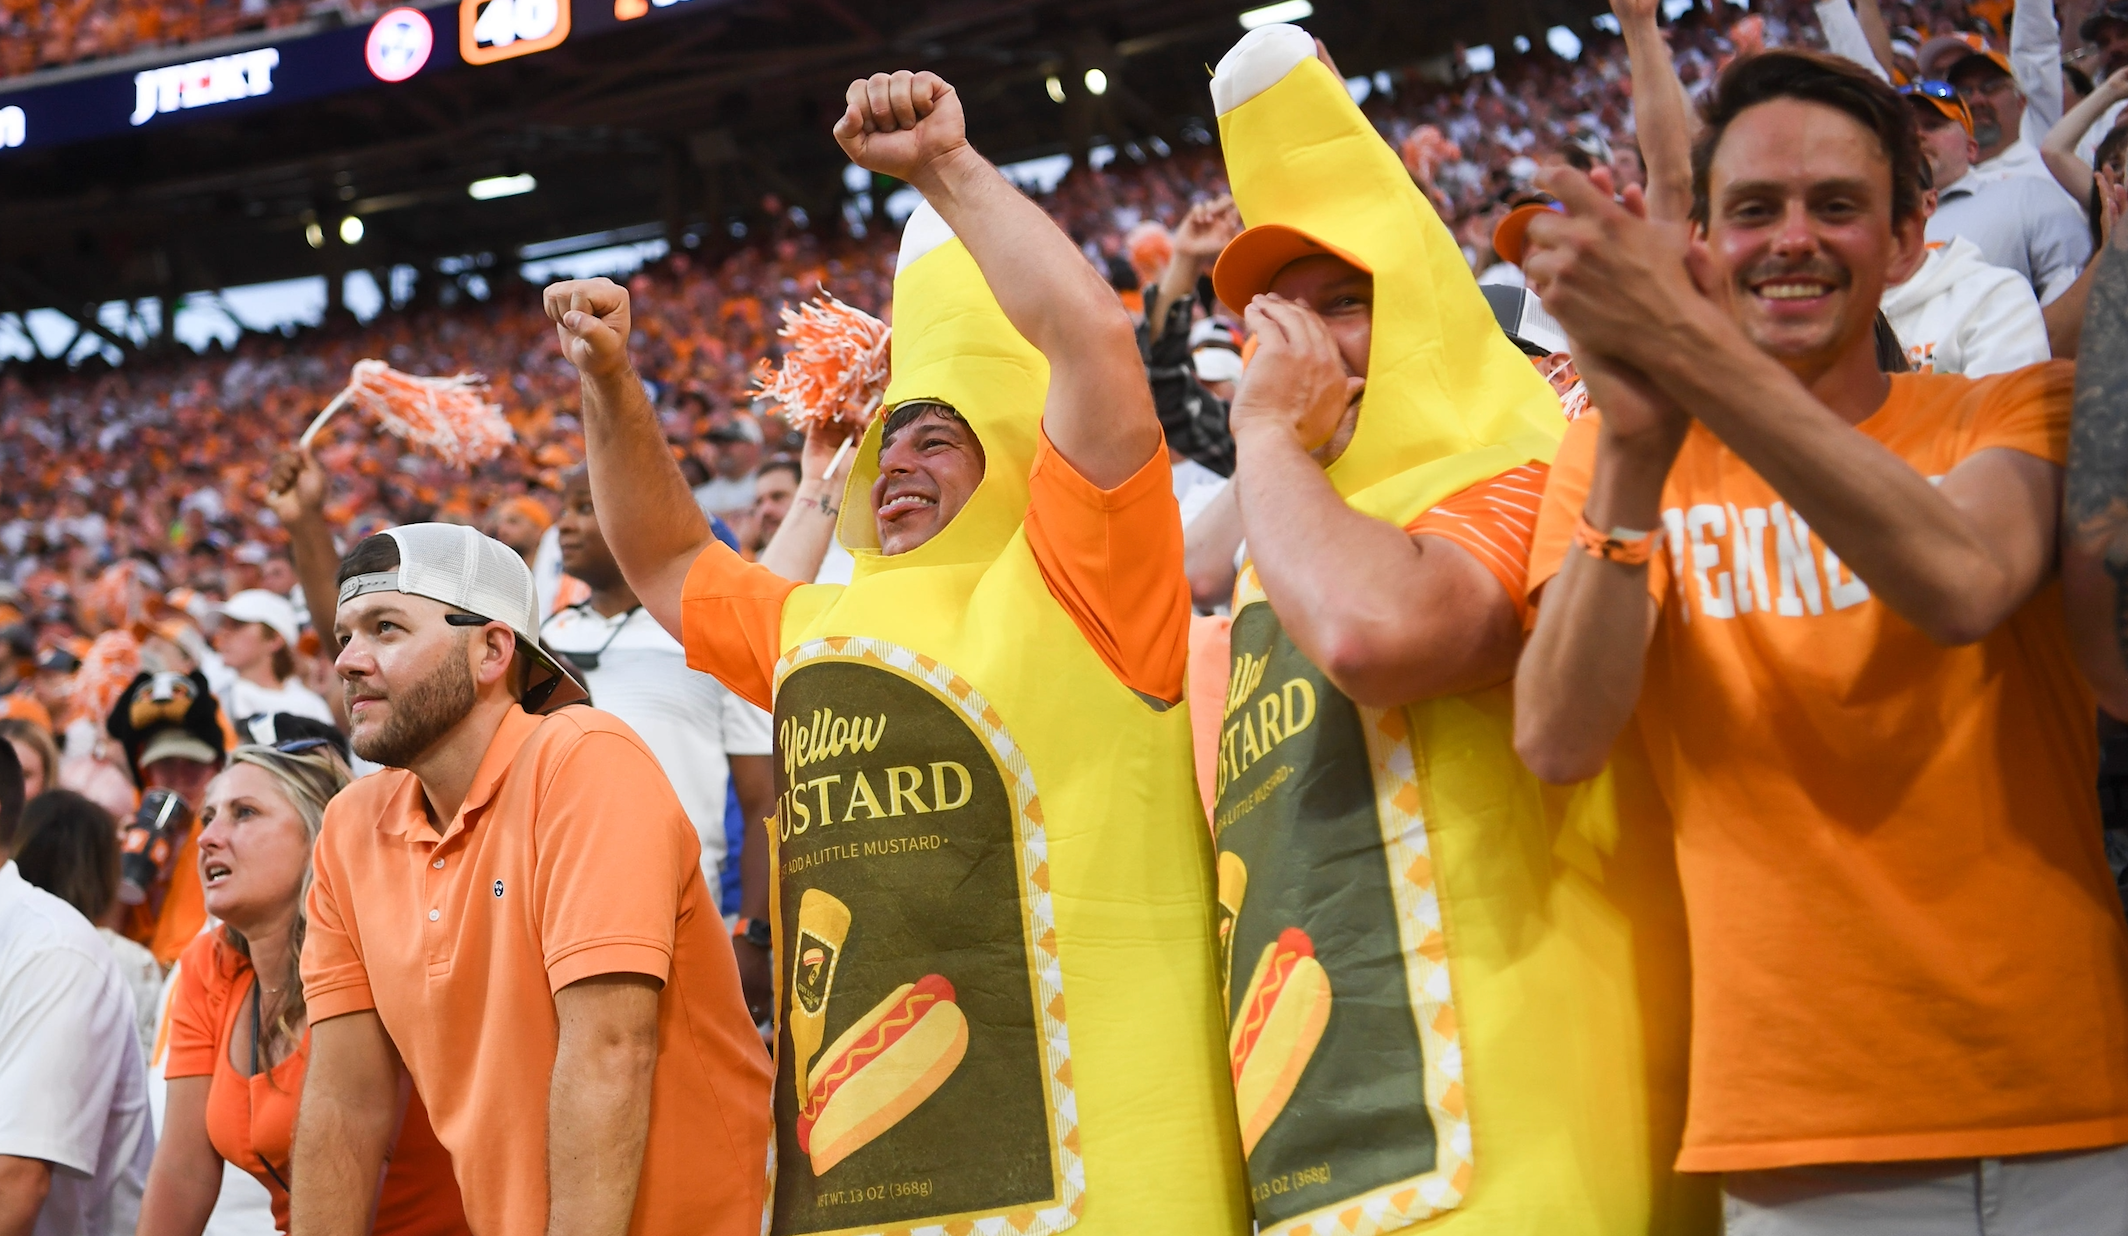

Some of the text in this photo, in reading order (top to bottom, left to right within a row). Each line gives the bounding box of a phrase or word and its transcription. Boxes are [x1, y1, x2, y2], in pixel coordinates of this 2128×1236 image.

[1662, 501, 1871, 624] ENN
[1223, 645, 1274, 721] llow
[779, 707, 887, 790] Yellow
[1213, 677, 1317, 809] STARD
[777, 760, 974, 843] USTARD
[814, 843, 860, 866] LITTLE
[864, 834, 941, 857] MUSTARD
[850, 1189, 864, 1204] 13
[866, 1186, 885, 1201] OZ
[889, 1178, 933, 1200] (368g)
